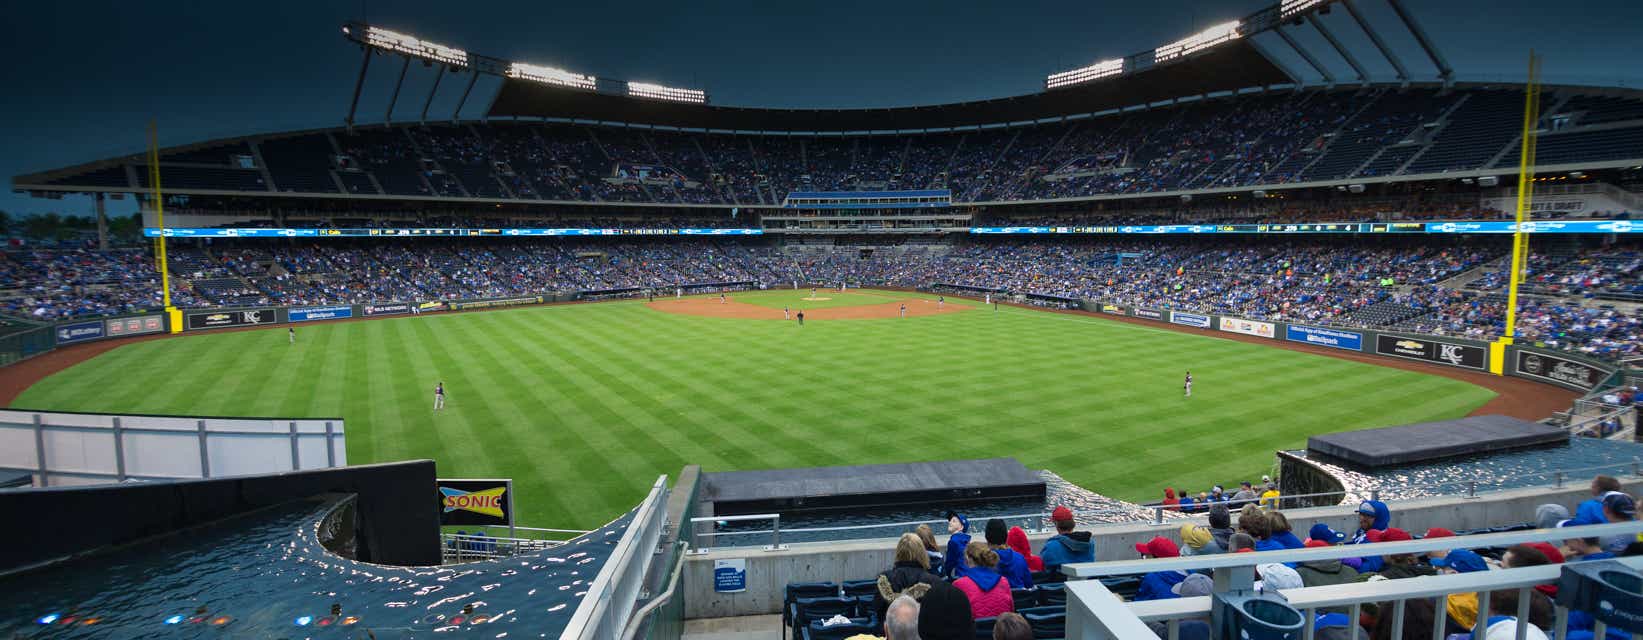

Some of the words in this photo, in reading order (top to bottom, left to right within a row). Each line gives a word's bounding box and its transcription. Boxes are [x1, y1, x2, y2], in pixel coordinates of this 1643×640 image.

[244, 311, 260, 324] KC
[1440, 344, 1463, 365] KC
[447, 495, 502, 508] SONIC
